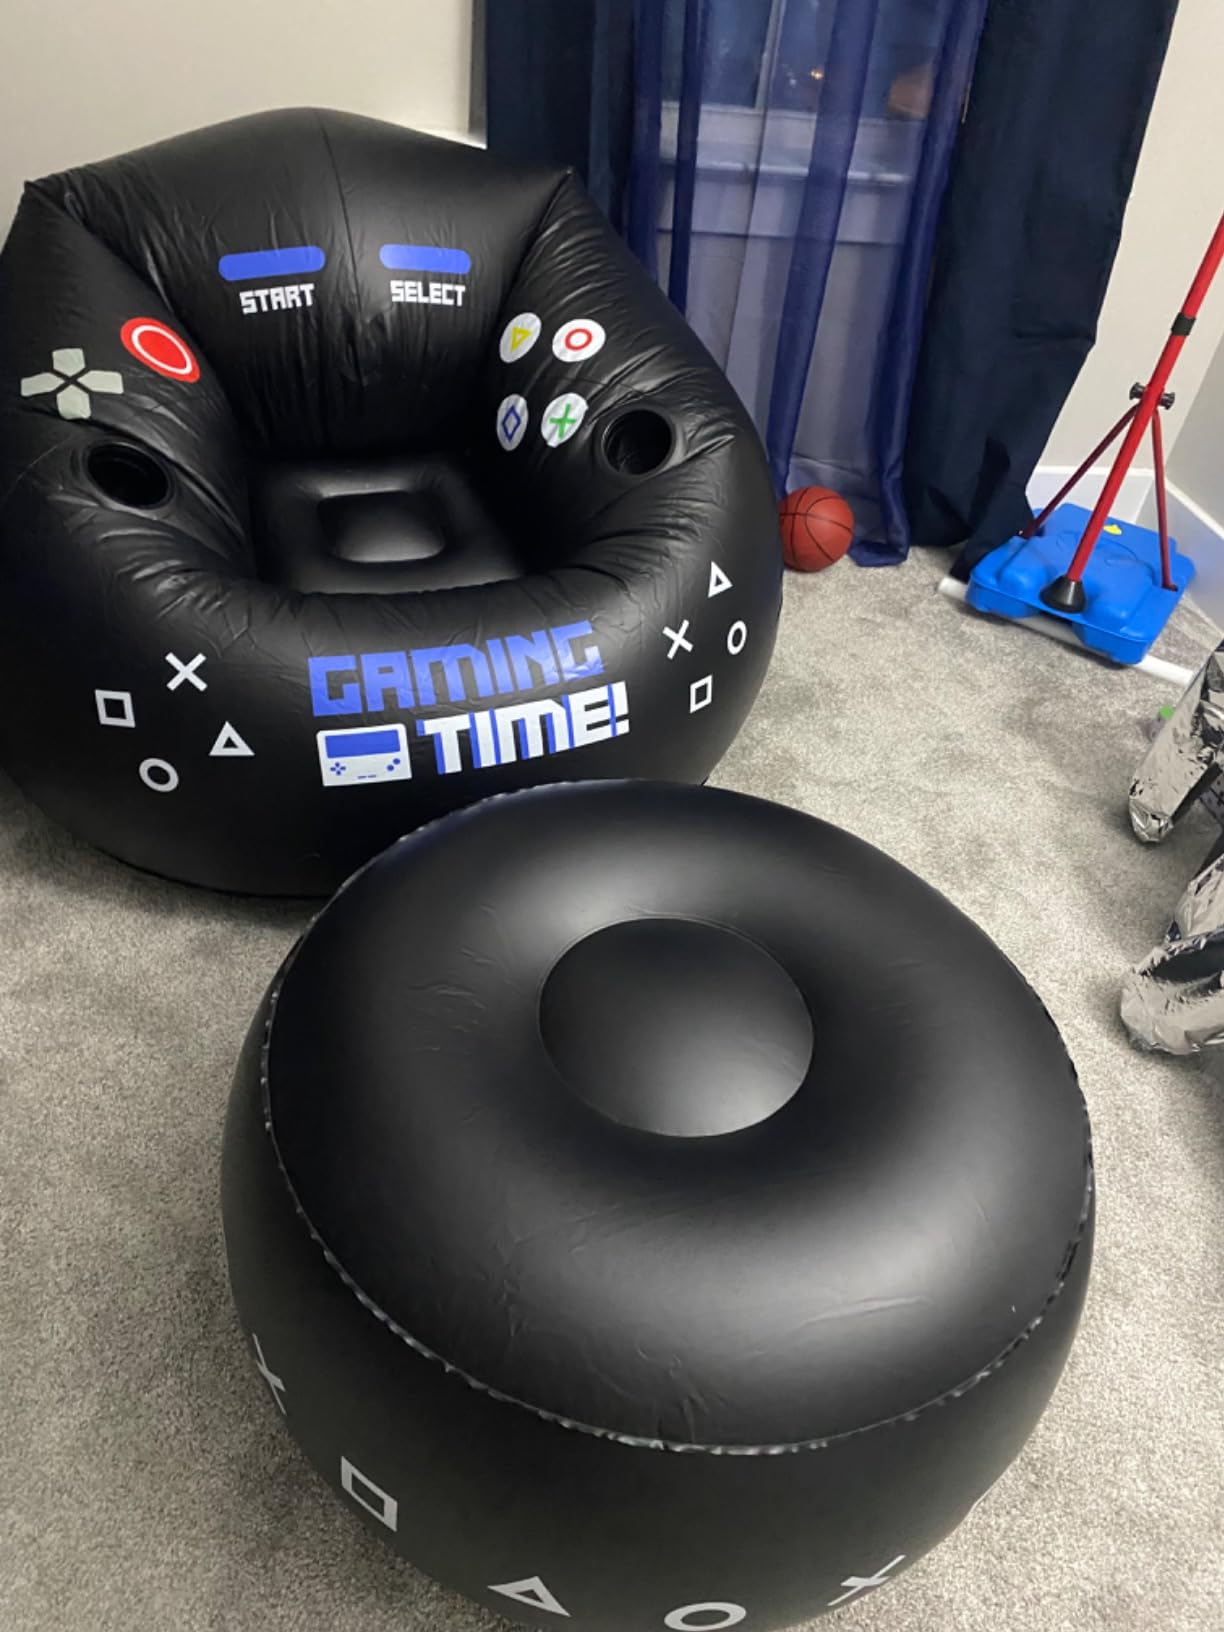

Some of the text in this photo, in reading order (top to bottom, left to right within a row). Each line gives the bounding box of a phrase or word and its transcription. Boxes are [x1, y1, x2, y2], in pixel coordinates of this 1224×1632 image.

[239, 283, 315, 314] START
[390, 280, 466, 307] SELECT
[308, 620, 604, 717] GAMING
[417, 681, 630, 775] TIME!
